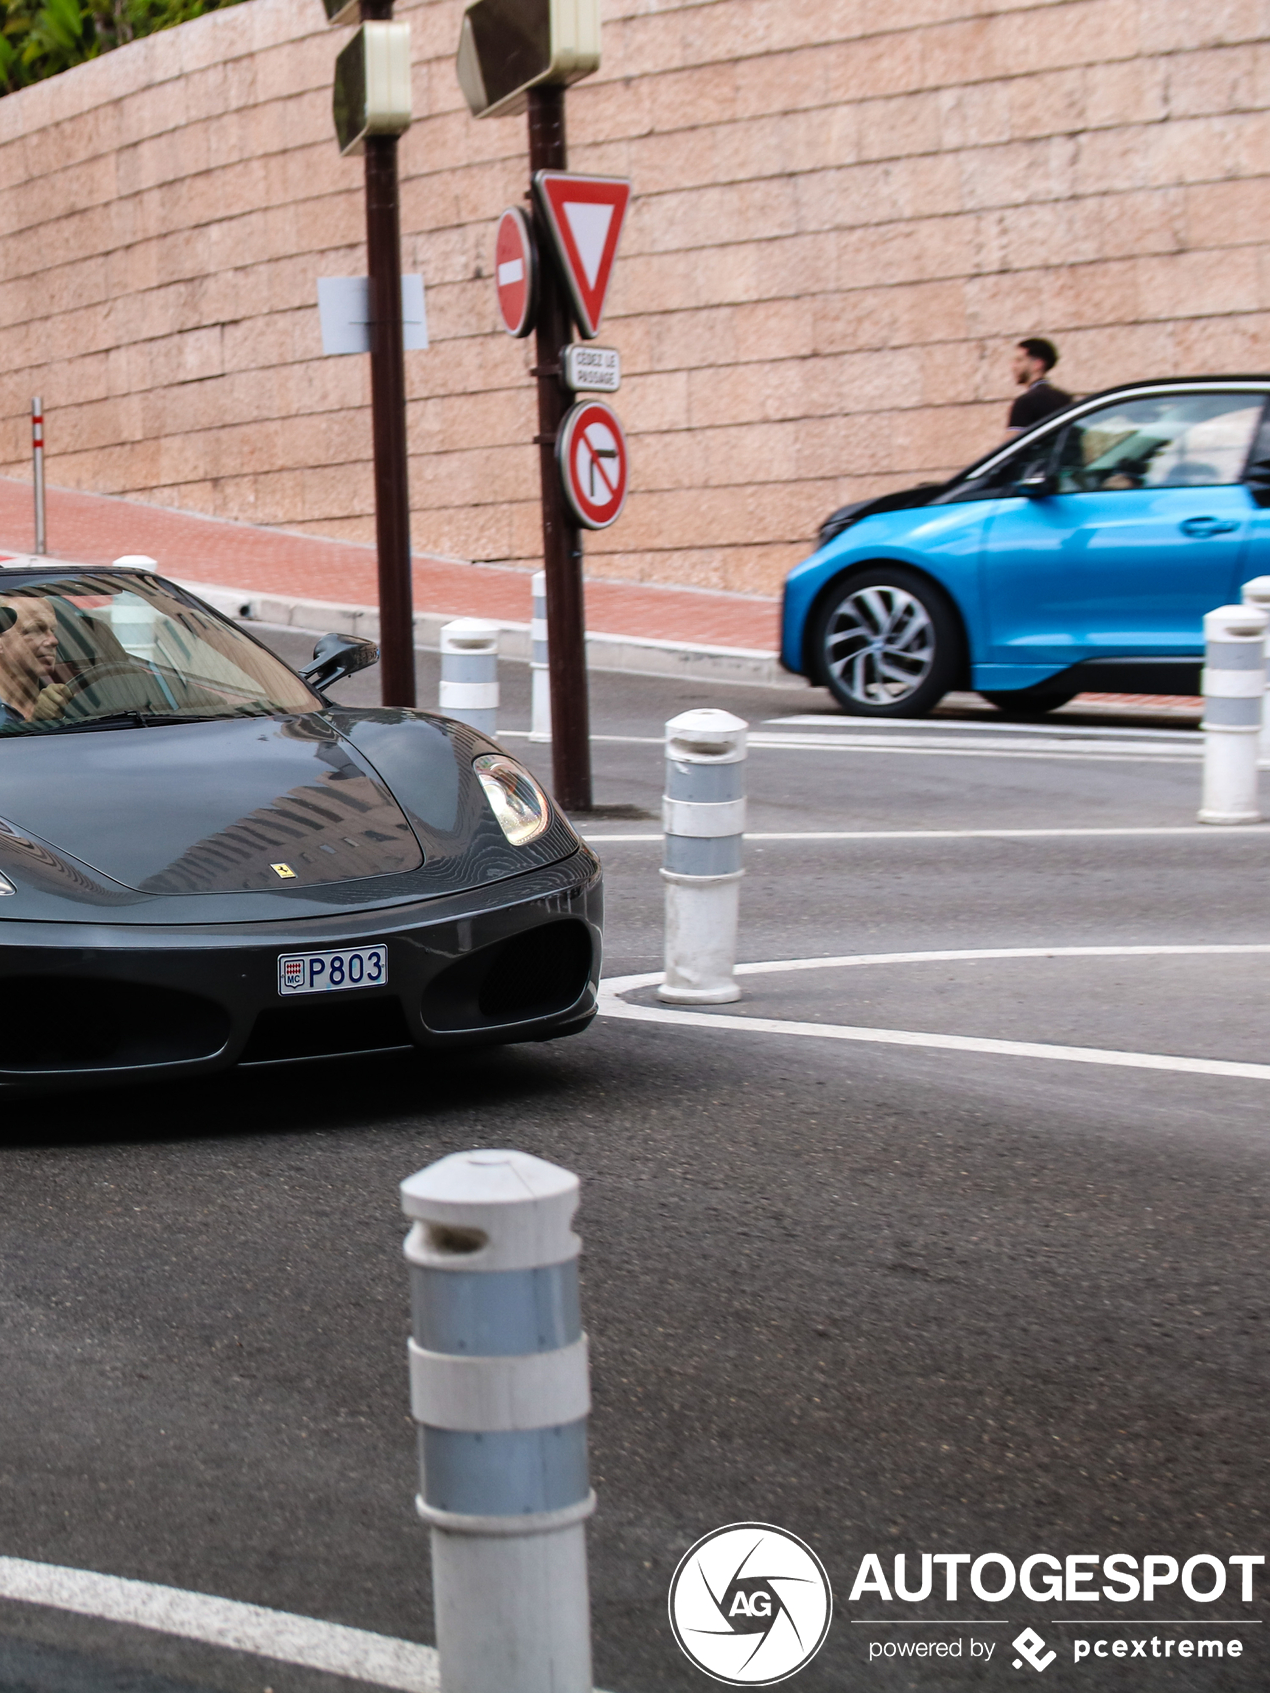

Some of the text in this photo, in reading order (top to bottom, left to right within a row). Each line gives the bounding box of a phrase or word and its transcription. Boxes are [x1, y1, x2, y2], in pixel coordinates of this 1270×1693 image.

[605, 354, 616, 368] LE
[287, 951, 382, 988] MC P803
